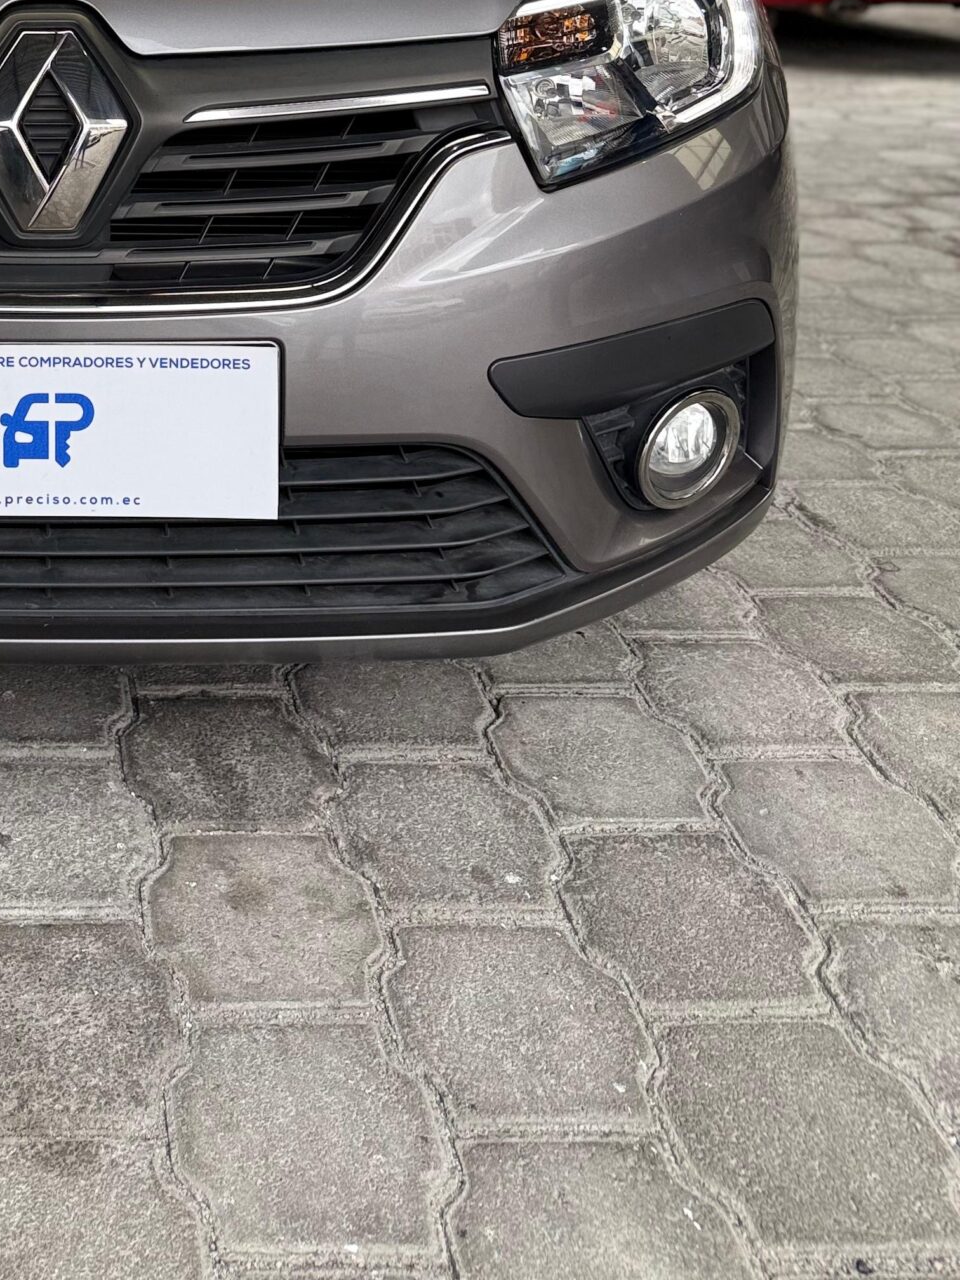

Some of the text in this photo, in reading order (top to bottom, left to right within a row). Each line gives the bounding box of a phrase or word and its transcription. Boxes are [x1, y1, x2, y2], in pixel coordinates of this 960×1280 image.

[18, 356, 134, 369] COMPRADORES
[136, 357, 147, 369] Y
[148, 357, 251, 370] VENDEDORES
